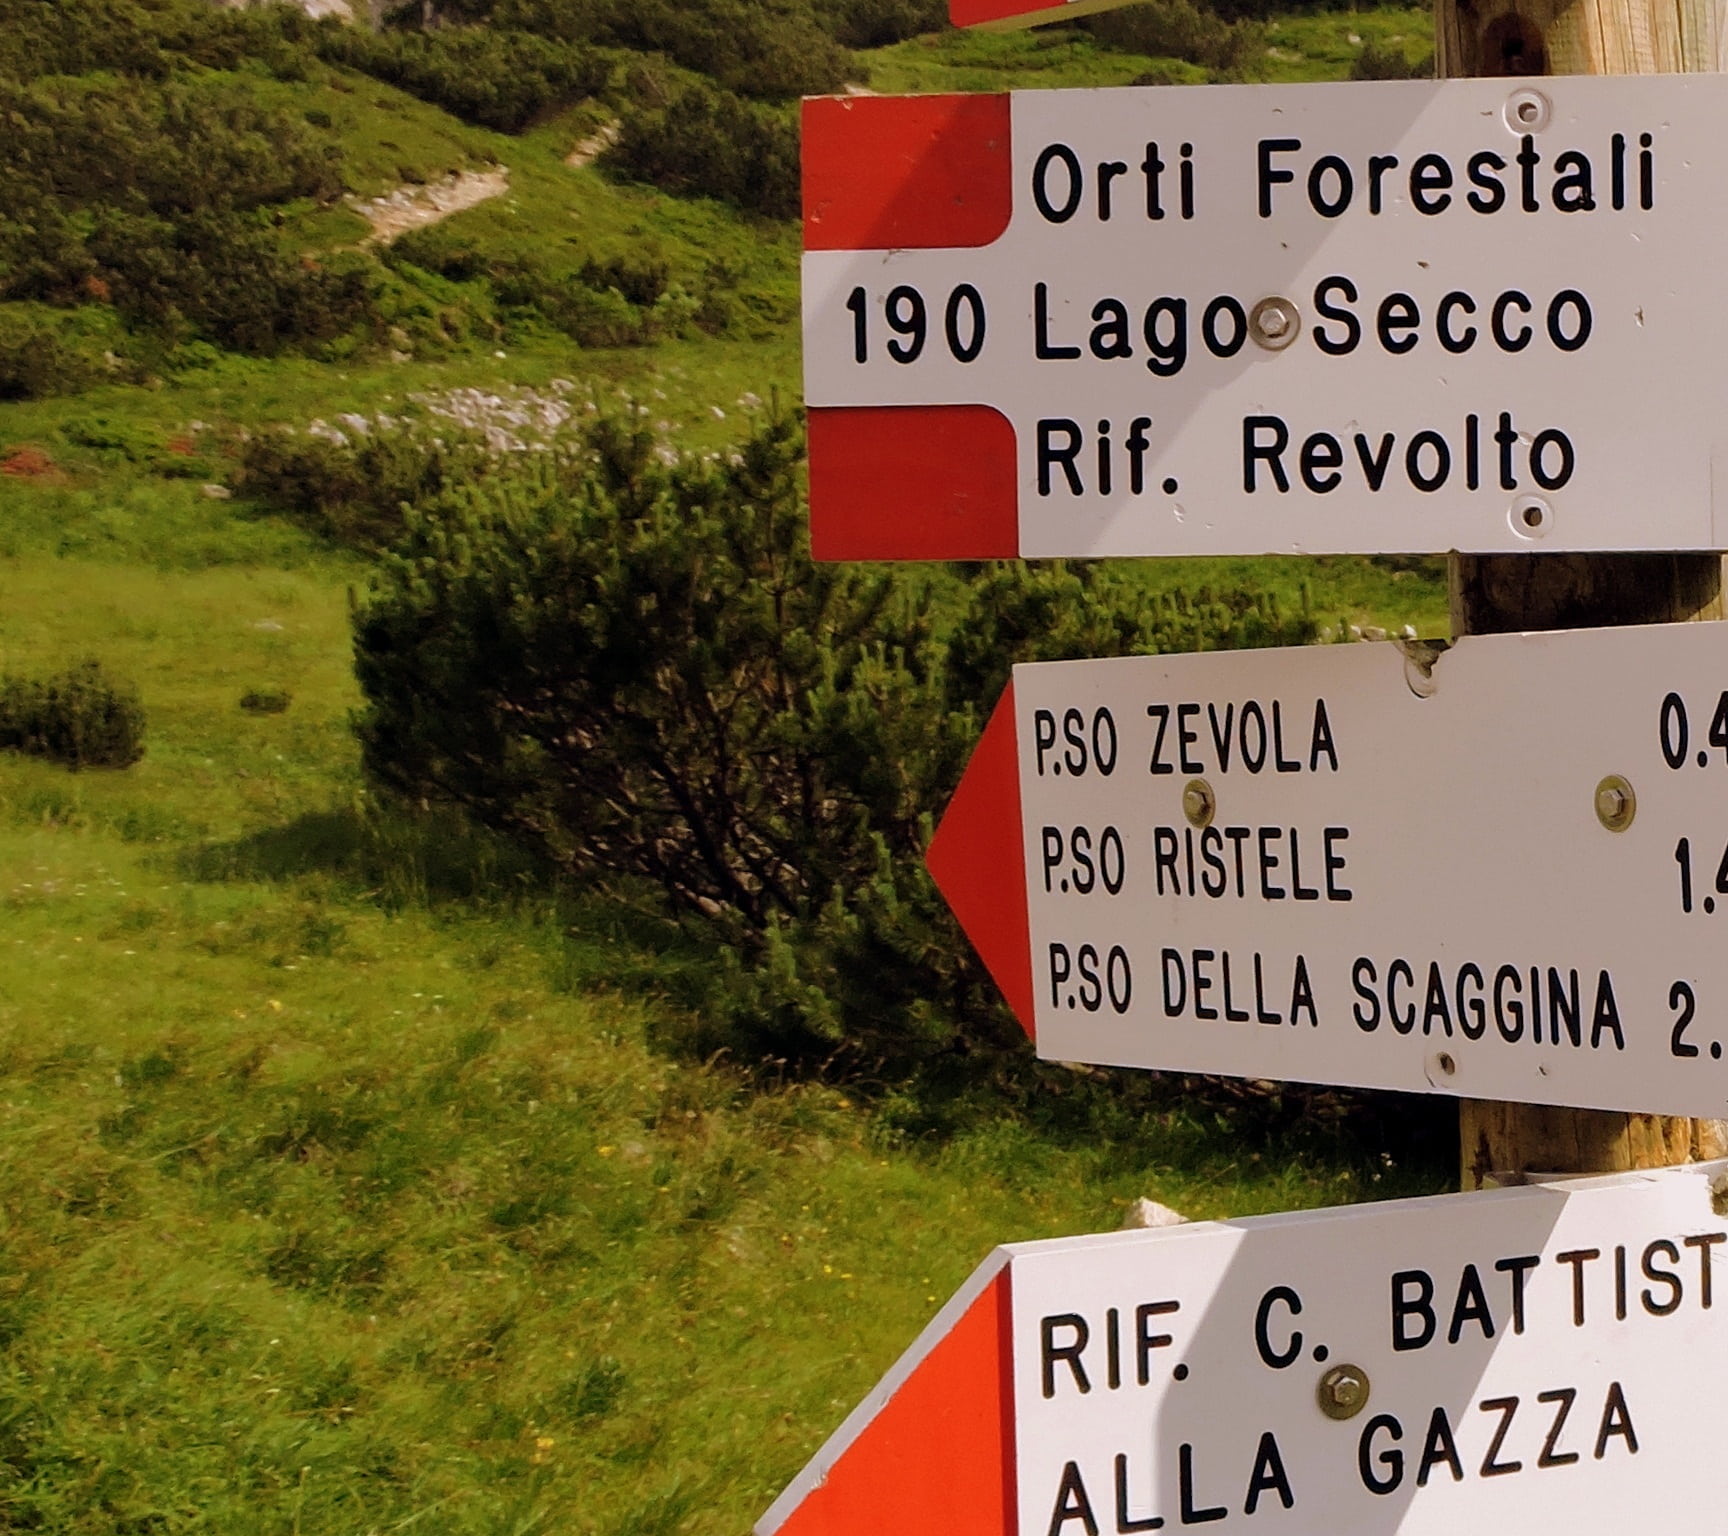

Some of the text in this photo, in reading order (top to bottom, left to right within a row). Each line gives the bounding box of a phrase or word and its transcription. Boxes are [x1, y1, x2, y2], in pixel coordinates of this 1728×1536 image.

[1032, 142, 1194, 224] Orti
[1258, 133, 1653, 218] Forestali
[846, 283, 986, 364] 190
[1034, 282, 1248, 377] Lago
[1312, 276, 1592, 356] Secco
[1037, 417, 1178, 496] Rif.
[1243, 412, 1574, 494] Revolto
[1035, 707, 1117, 777] P.SO
[1147, 698, 1338, 775] ZEVOLA
[1042, 826, 1125, 895] P.SO
[1154, 826, 1352, 901] RISTELE
[1049, 943, 1131, 1014] P.SO
[1161, 948, 1318, 1027] DELLA
[1352, 957, 1624, 1050] SCAGGINA
[1040, 1300, 1189, 1399] RIF.
[1255, 1286, 1328, 1369] C.
[1358, 1379, 1639, 1495] GAZZA
